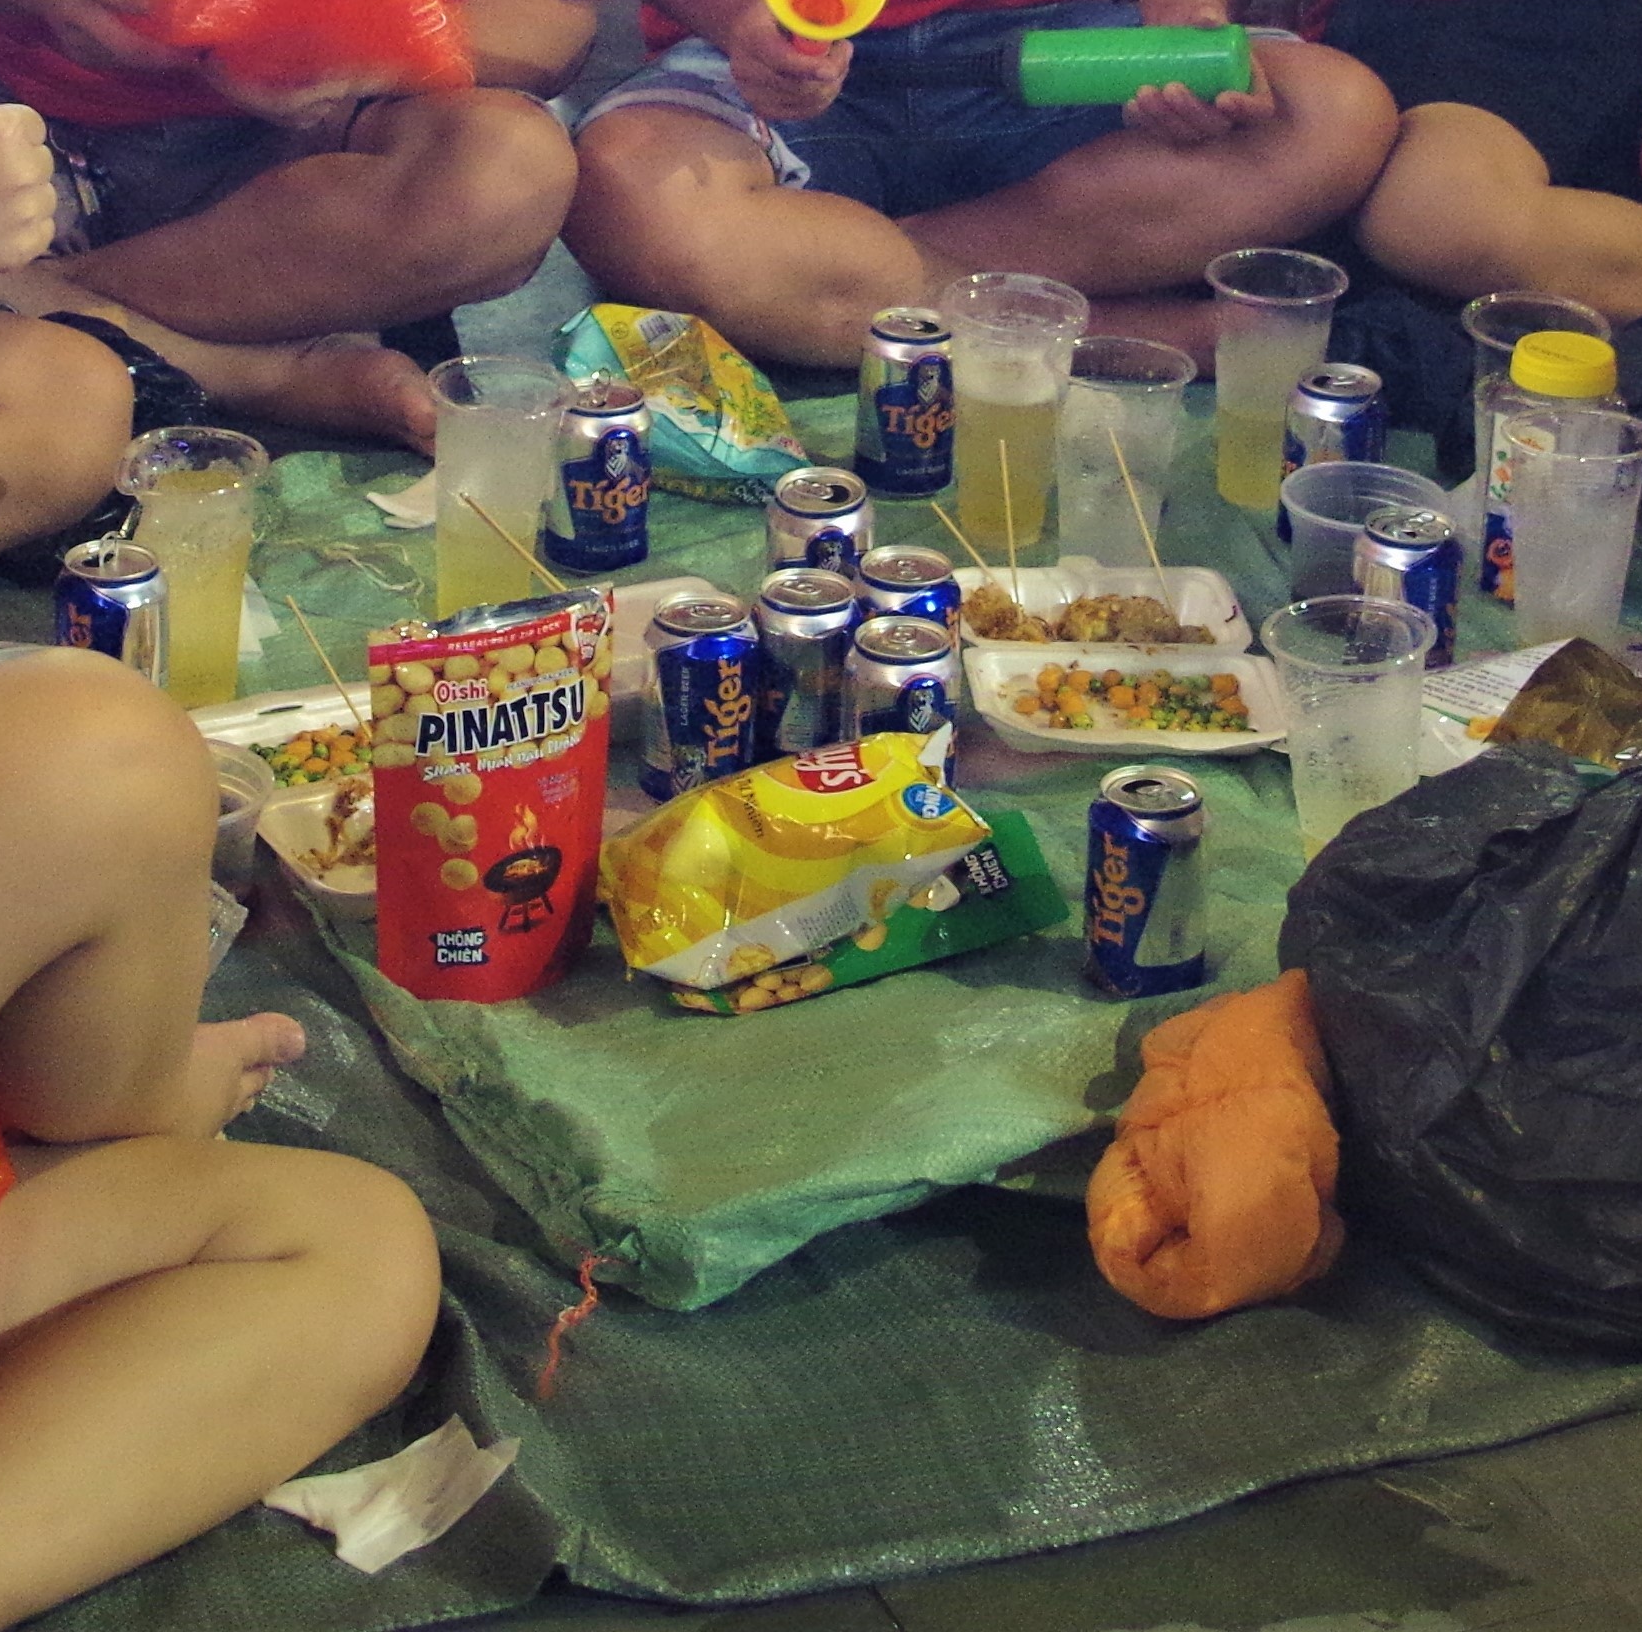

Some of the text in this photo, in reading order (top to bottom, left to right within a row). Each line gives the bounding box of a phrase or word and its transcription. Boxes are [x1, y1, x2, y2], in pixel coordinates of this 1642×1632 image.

[567, 476, 650, 525] Tiger
[434, 678, 487, 705] Oishi
[703, 658, 753, 768] Tiger
[414, 676, 586, 758] PINATTSU
[1091, 831, 1146, 947] Tiger
[436, 929, 484, 948] KHÔNG
[436, 946, 484, 964] CHIÊN
